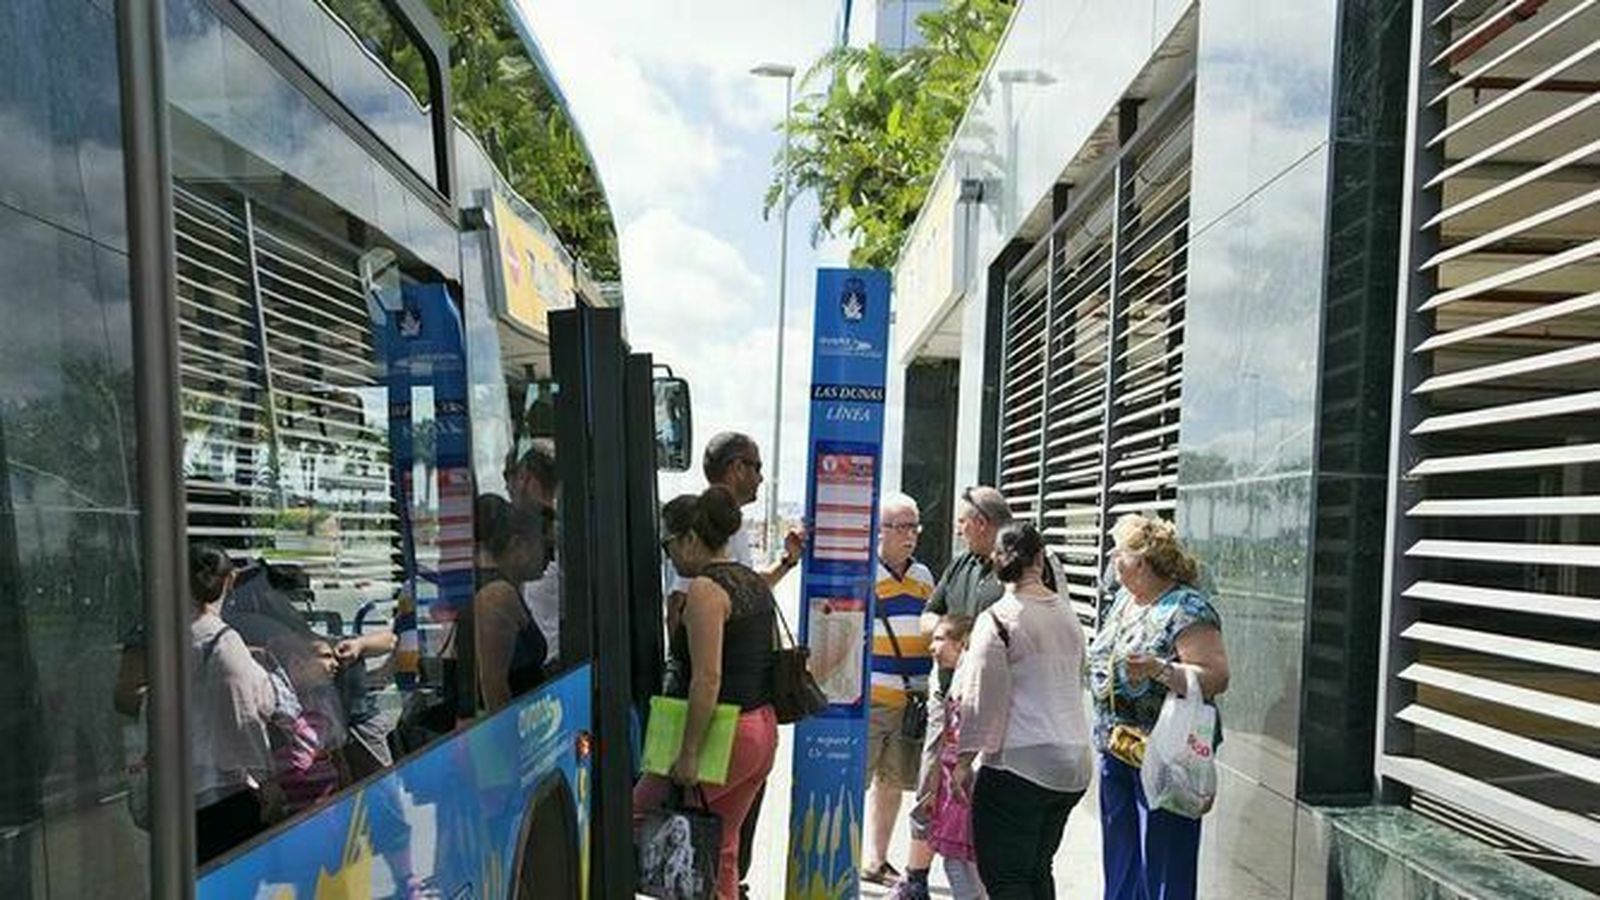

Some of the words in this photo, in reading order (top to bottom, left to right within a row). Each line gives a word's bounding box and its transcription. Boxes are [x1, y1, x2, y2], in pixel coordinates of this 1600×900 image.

[814, 386, 837, 398] LAS
[840, 387, 884, 400] DUNAS
[826, 403, 871, 421] LÍNEA
